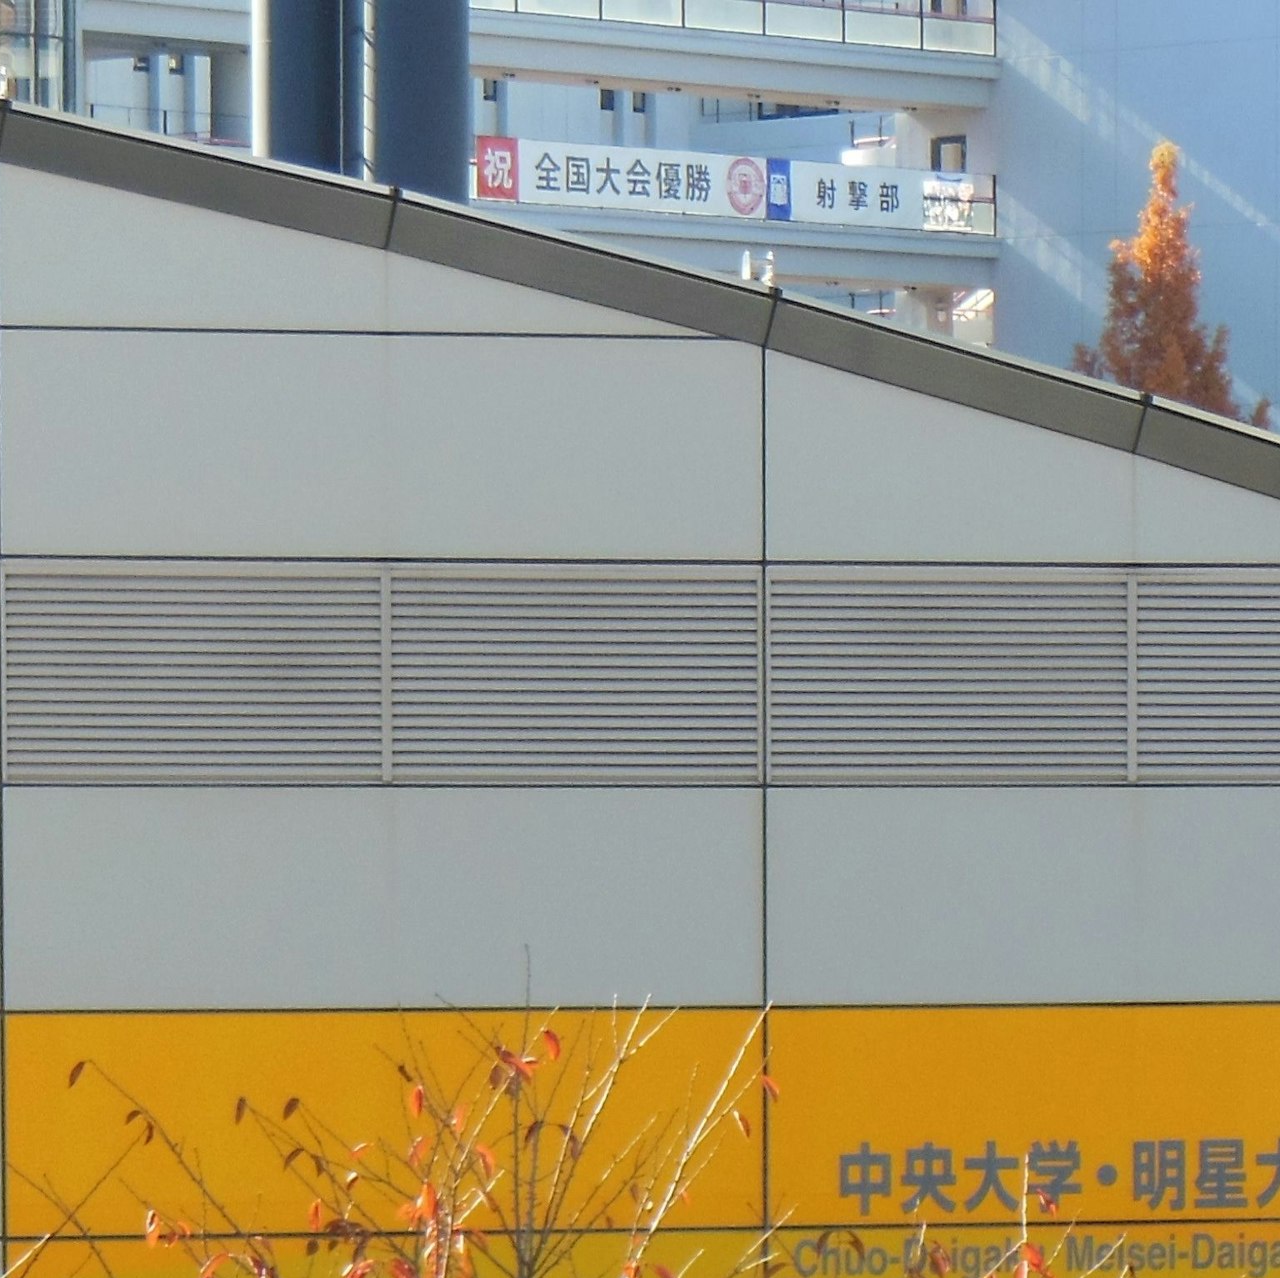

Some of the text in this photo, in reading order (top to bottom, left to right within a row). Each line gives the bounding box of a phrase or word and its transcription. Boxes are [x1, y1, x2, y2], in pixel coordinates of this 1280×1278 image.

[483, 147, 900, 213] 祝 全国大会優勝 射撃部
